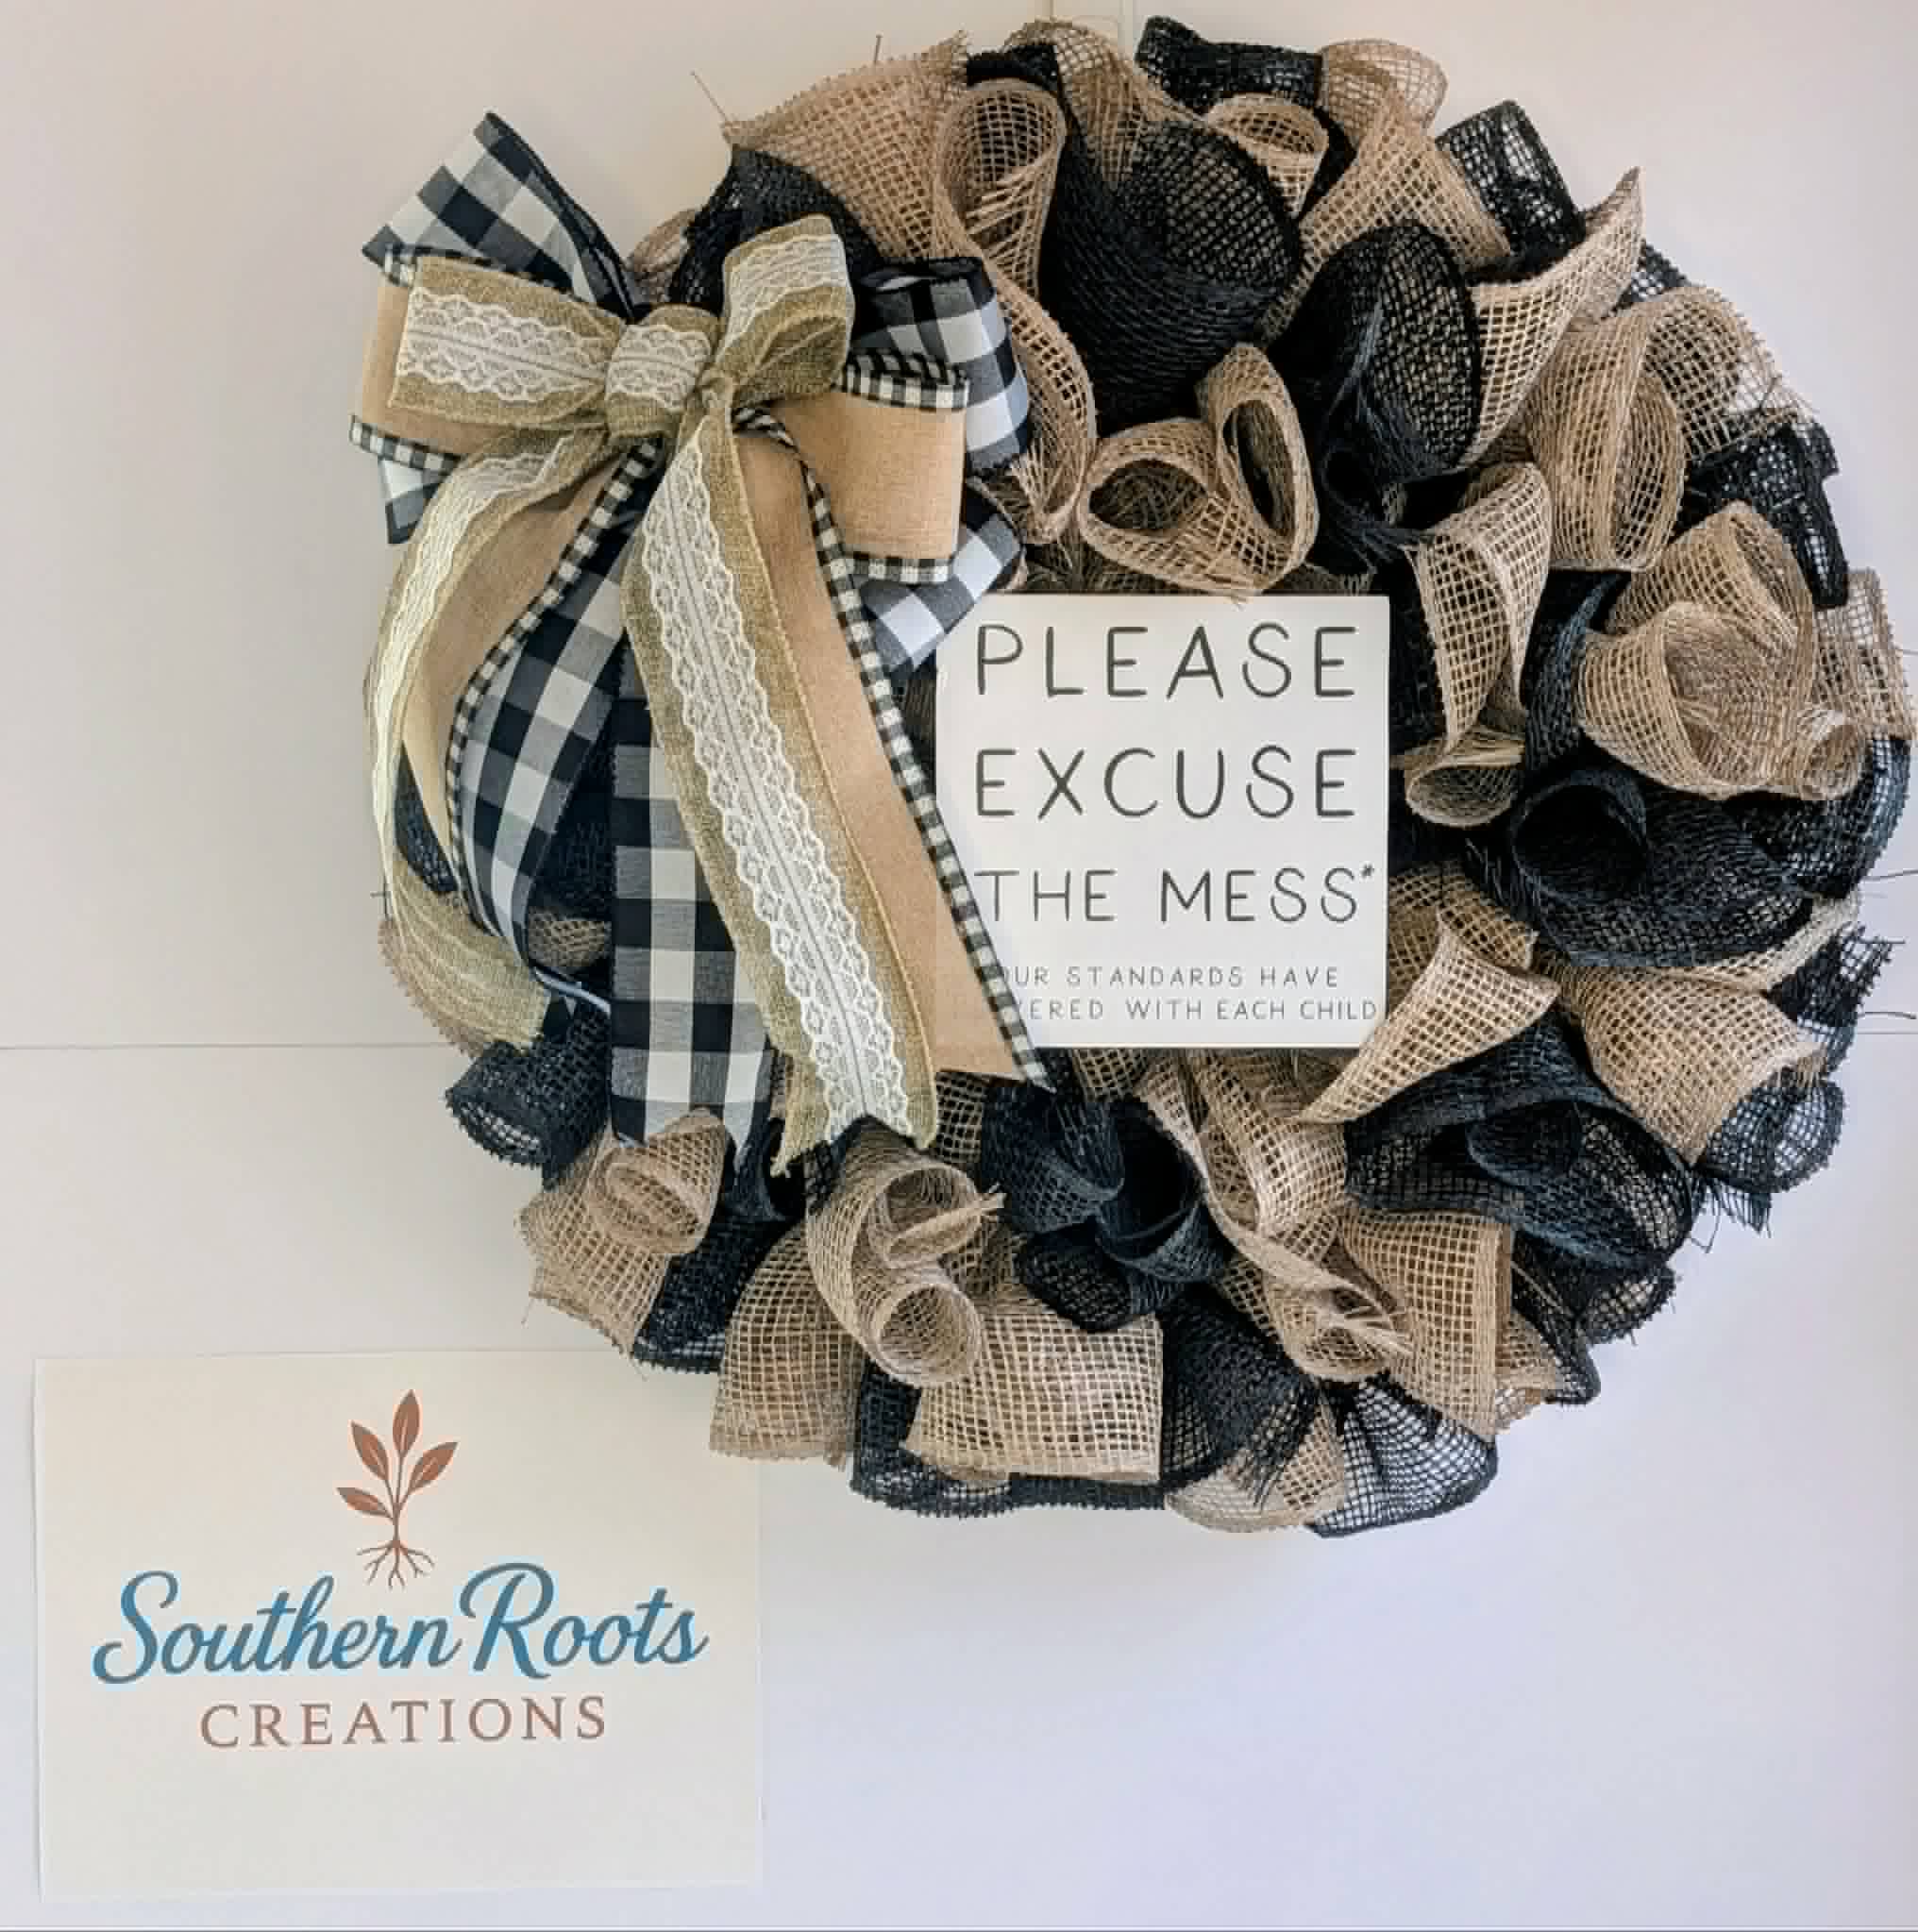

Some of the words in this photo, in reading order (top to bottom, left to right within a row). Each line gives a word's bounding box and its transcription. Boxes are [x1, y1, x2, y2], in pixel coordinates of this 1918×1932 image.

[976, 622, 1356, 699] PLEASE
[976, 745, 1356, 820] EXCUSE
[974, 868, 1116, 922] THE
[1066, 966, 1243, 987] STANDARDS
[1260, 966, 1338, 987] HAVE
[1125, 999, 1203, 1020] WITH
[1217, 999, 1285, 1020] EACH
[1299, 999, 1376, 1021] CHILD
[93, 1570, 463, 1686] Southern
[459, 1561, 710, 1680] Roots
[199, 1695, 606, 1748] CREATIONS
